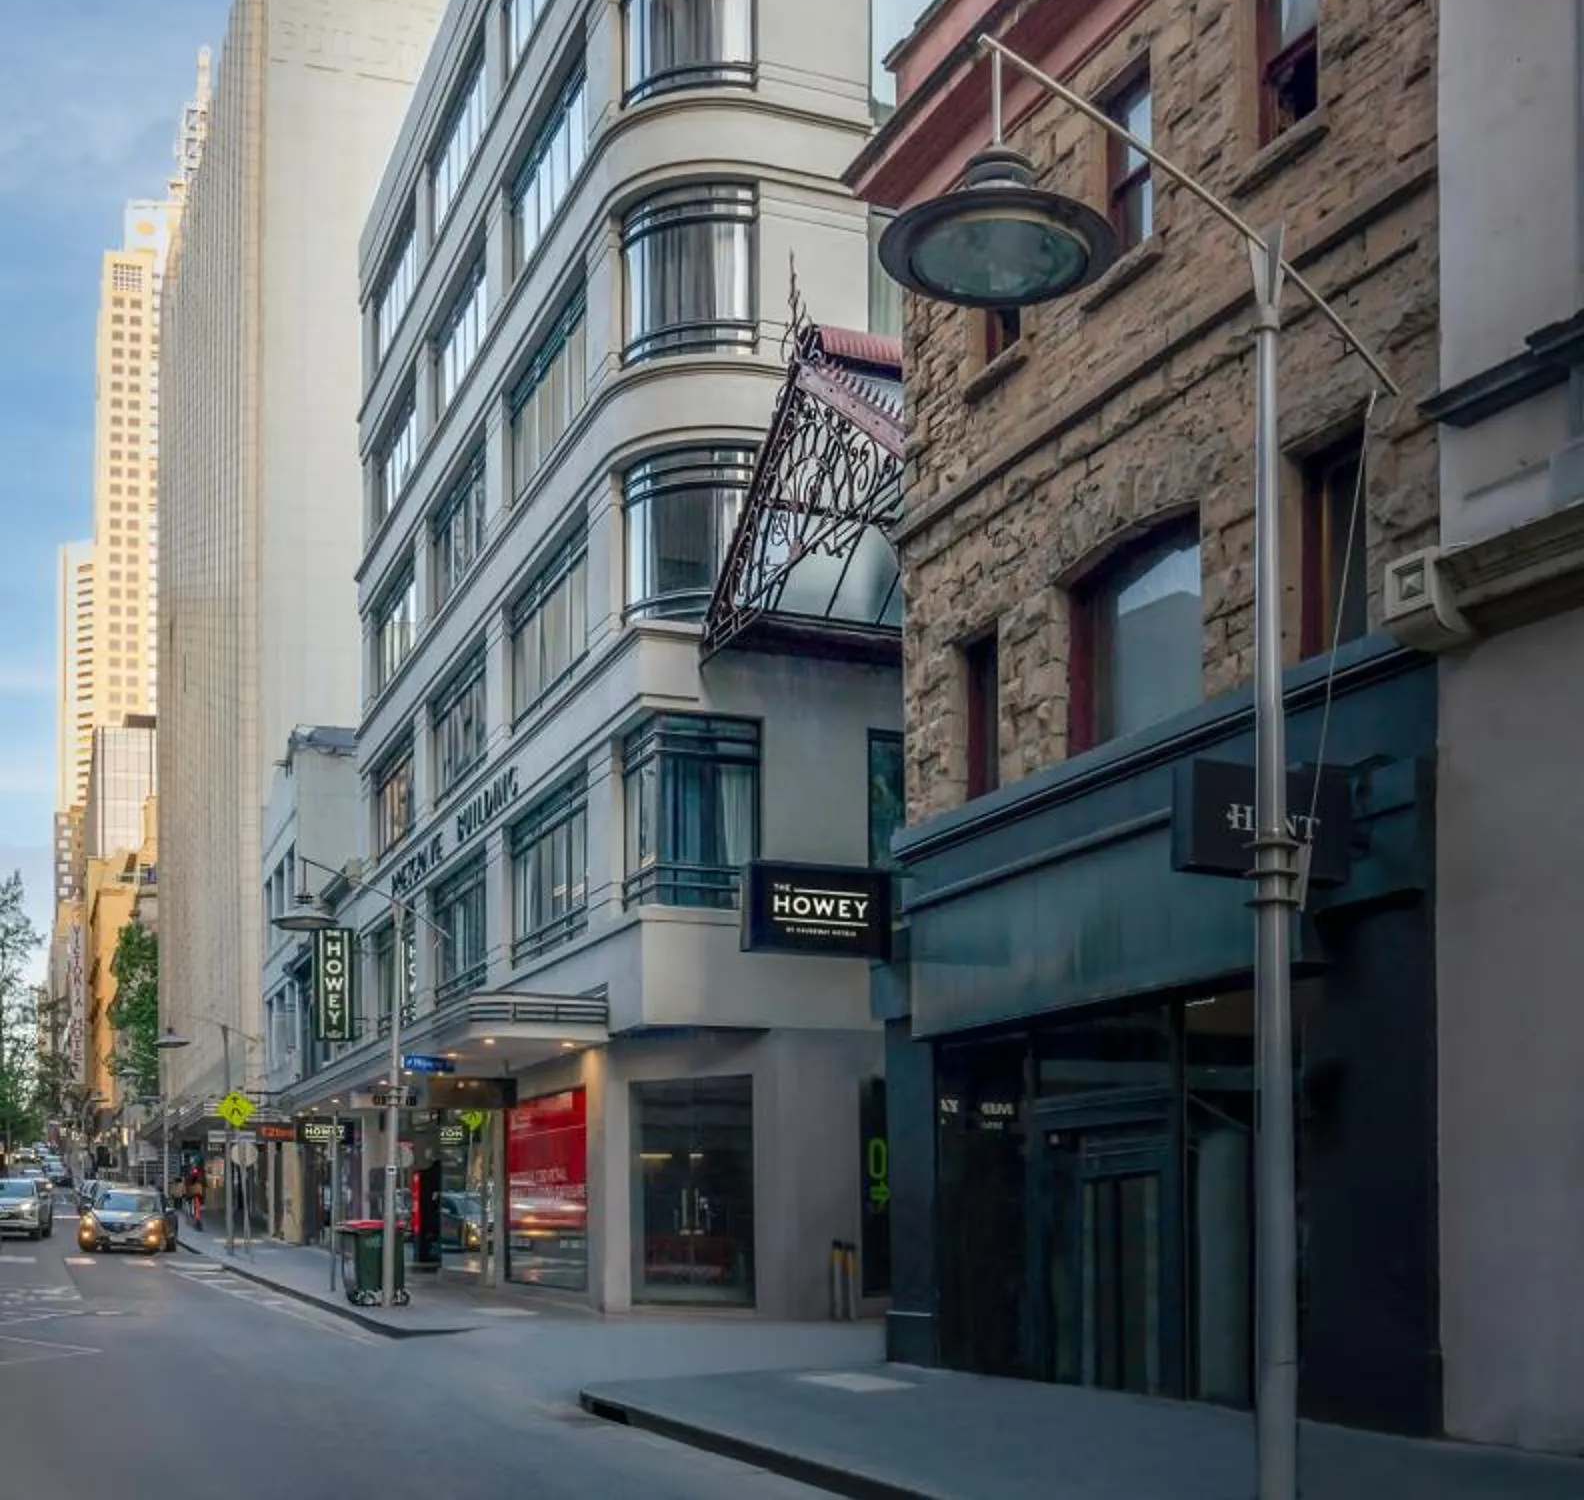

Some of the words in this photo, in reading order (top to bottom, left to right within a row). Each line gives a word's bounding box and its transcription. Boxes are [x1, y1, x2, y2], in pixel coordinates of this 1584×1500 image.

[457, 765, 519, 843] BUILDING
[1226, 803, 1320, 839] HNT
[773, 883, 791, 893] THE
[773, 894, 869, 919] HOWEY
[72, 925, 84, 1008] VICTORIA
[324, 940, 344, 1026] HOWEY
